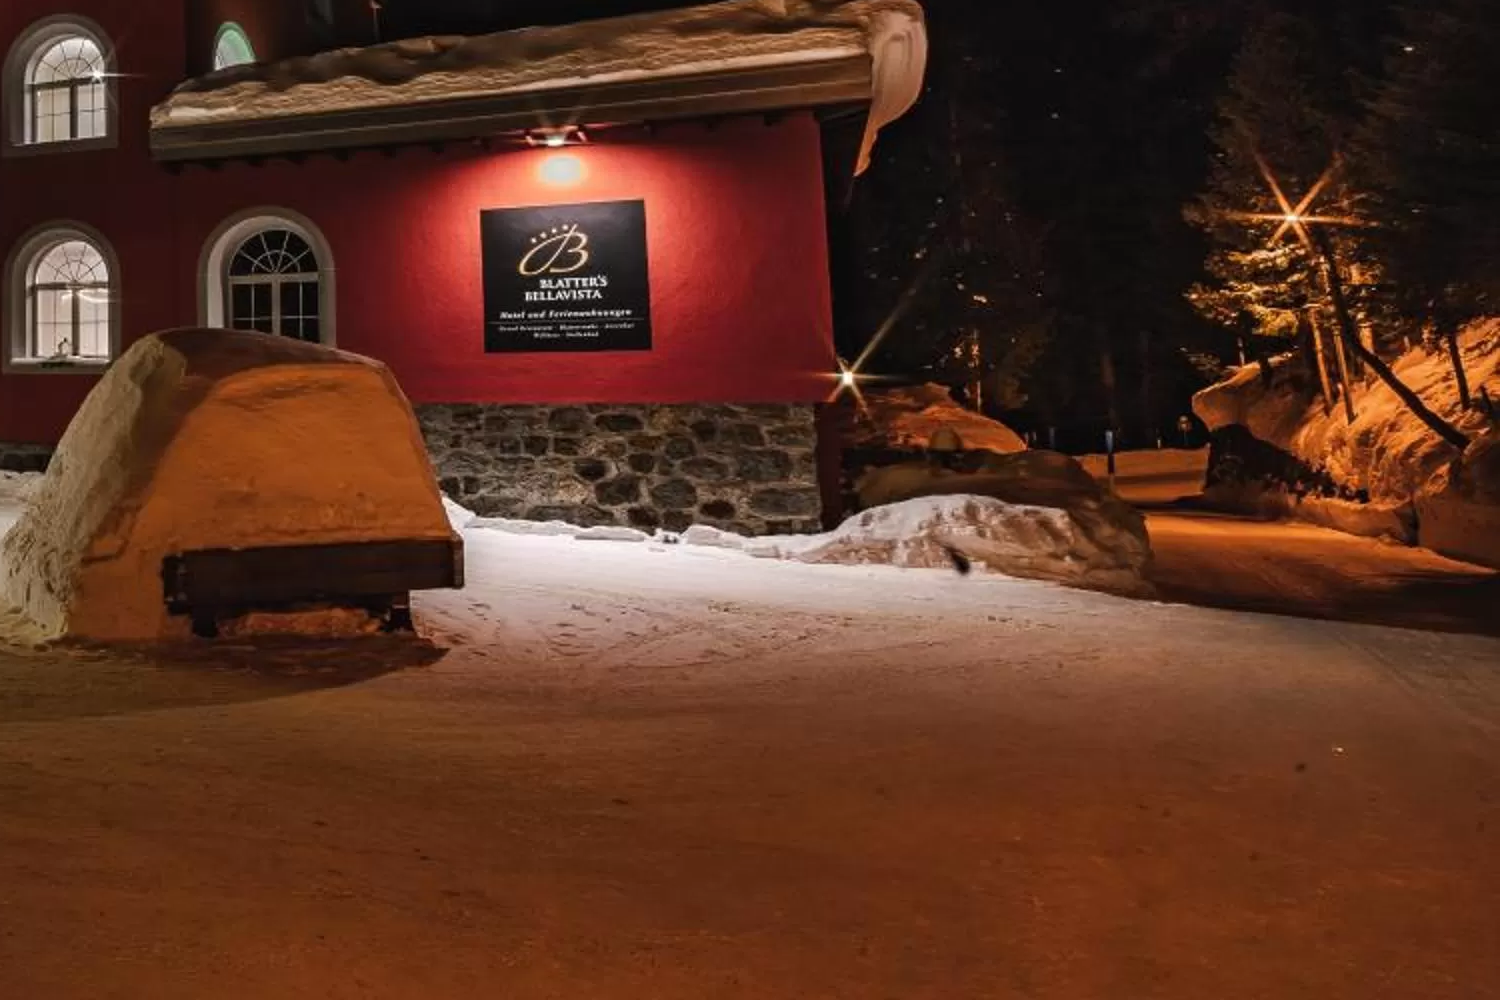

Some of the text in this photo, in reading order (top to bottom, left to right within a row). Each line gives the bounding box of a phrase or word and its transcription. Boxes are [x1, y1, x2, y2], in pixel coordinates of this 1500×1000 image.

[539, 275, 608, 289] BLATTER'S
[525, 289, 603, 302] BELLAVISTA
[527, 310, 546, 319] und
